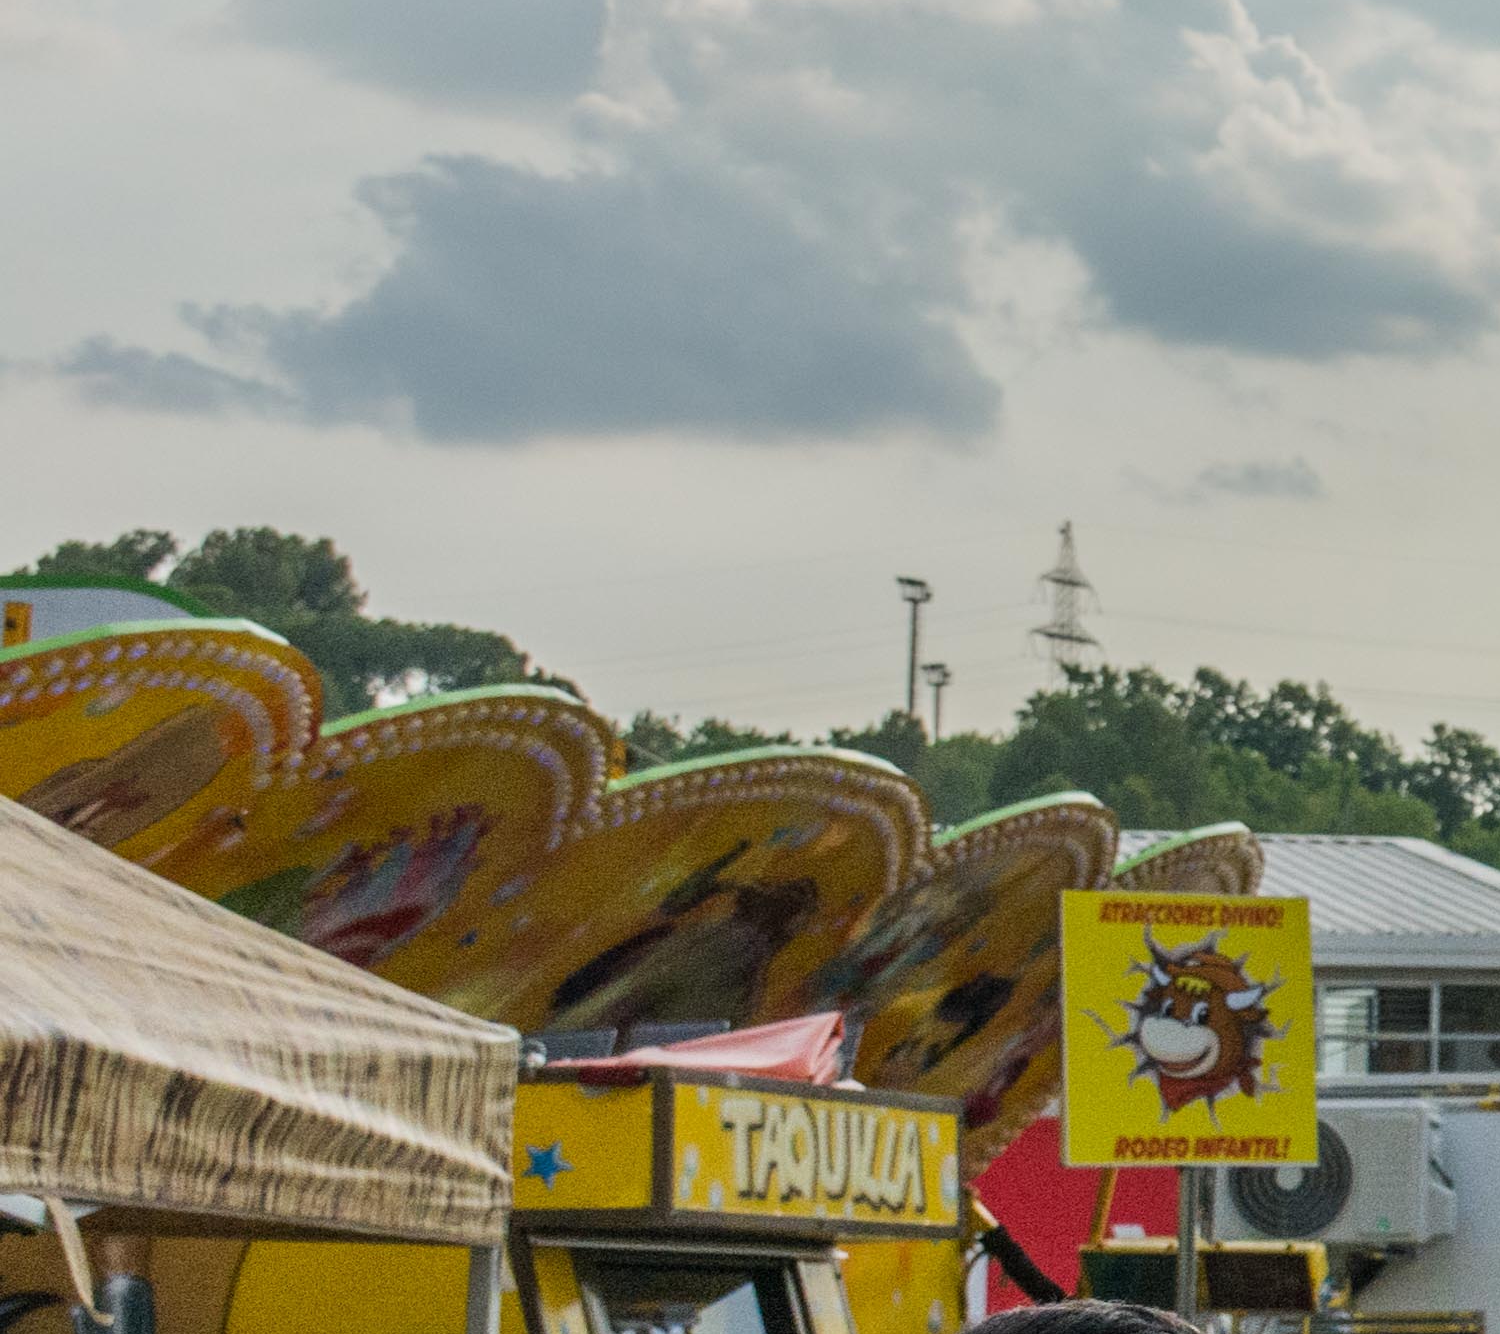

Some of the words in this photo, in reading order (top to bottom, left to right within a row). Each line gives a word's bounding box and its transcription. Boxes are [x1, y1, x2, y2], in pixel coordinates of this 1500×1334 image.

[719, 1098, 926, 1214] TAQUILLA
[1113, 1136, 1189, 1159] RODEO
[1193, 1136, 1292, 1159] INFANTIL!
